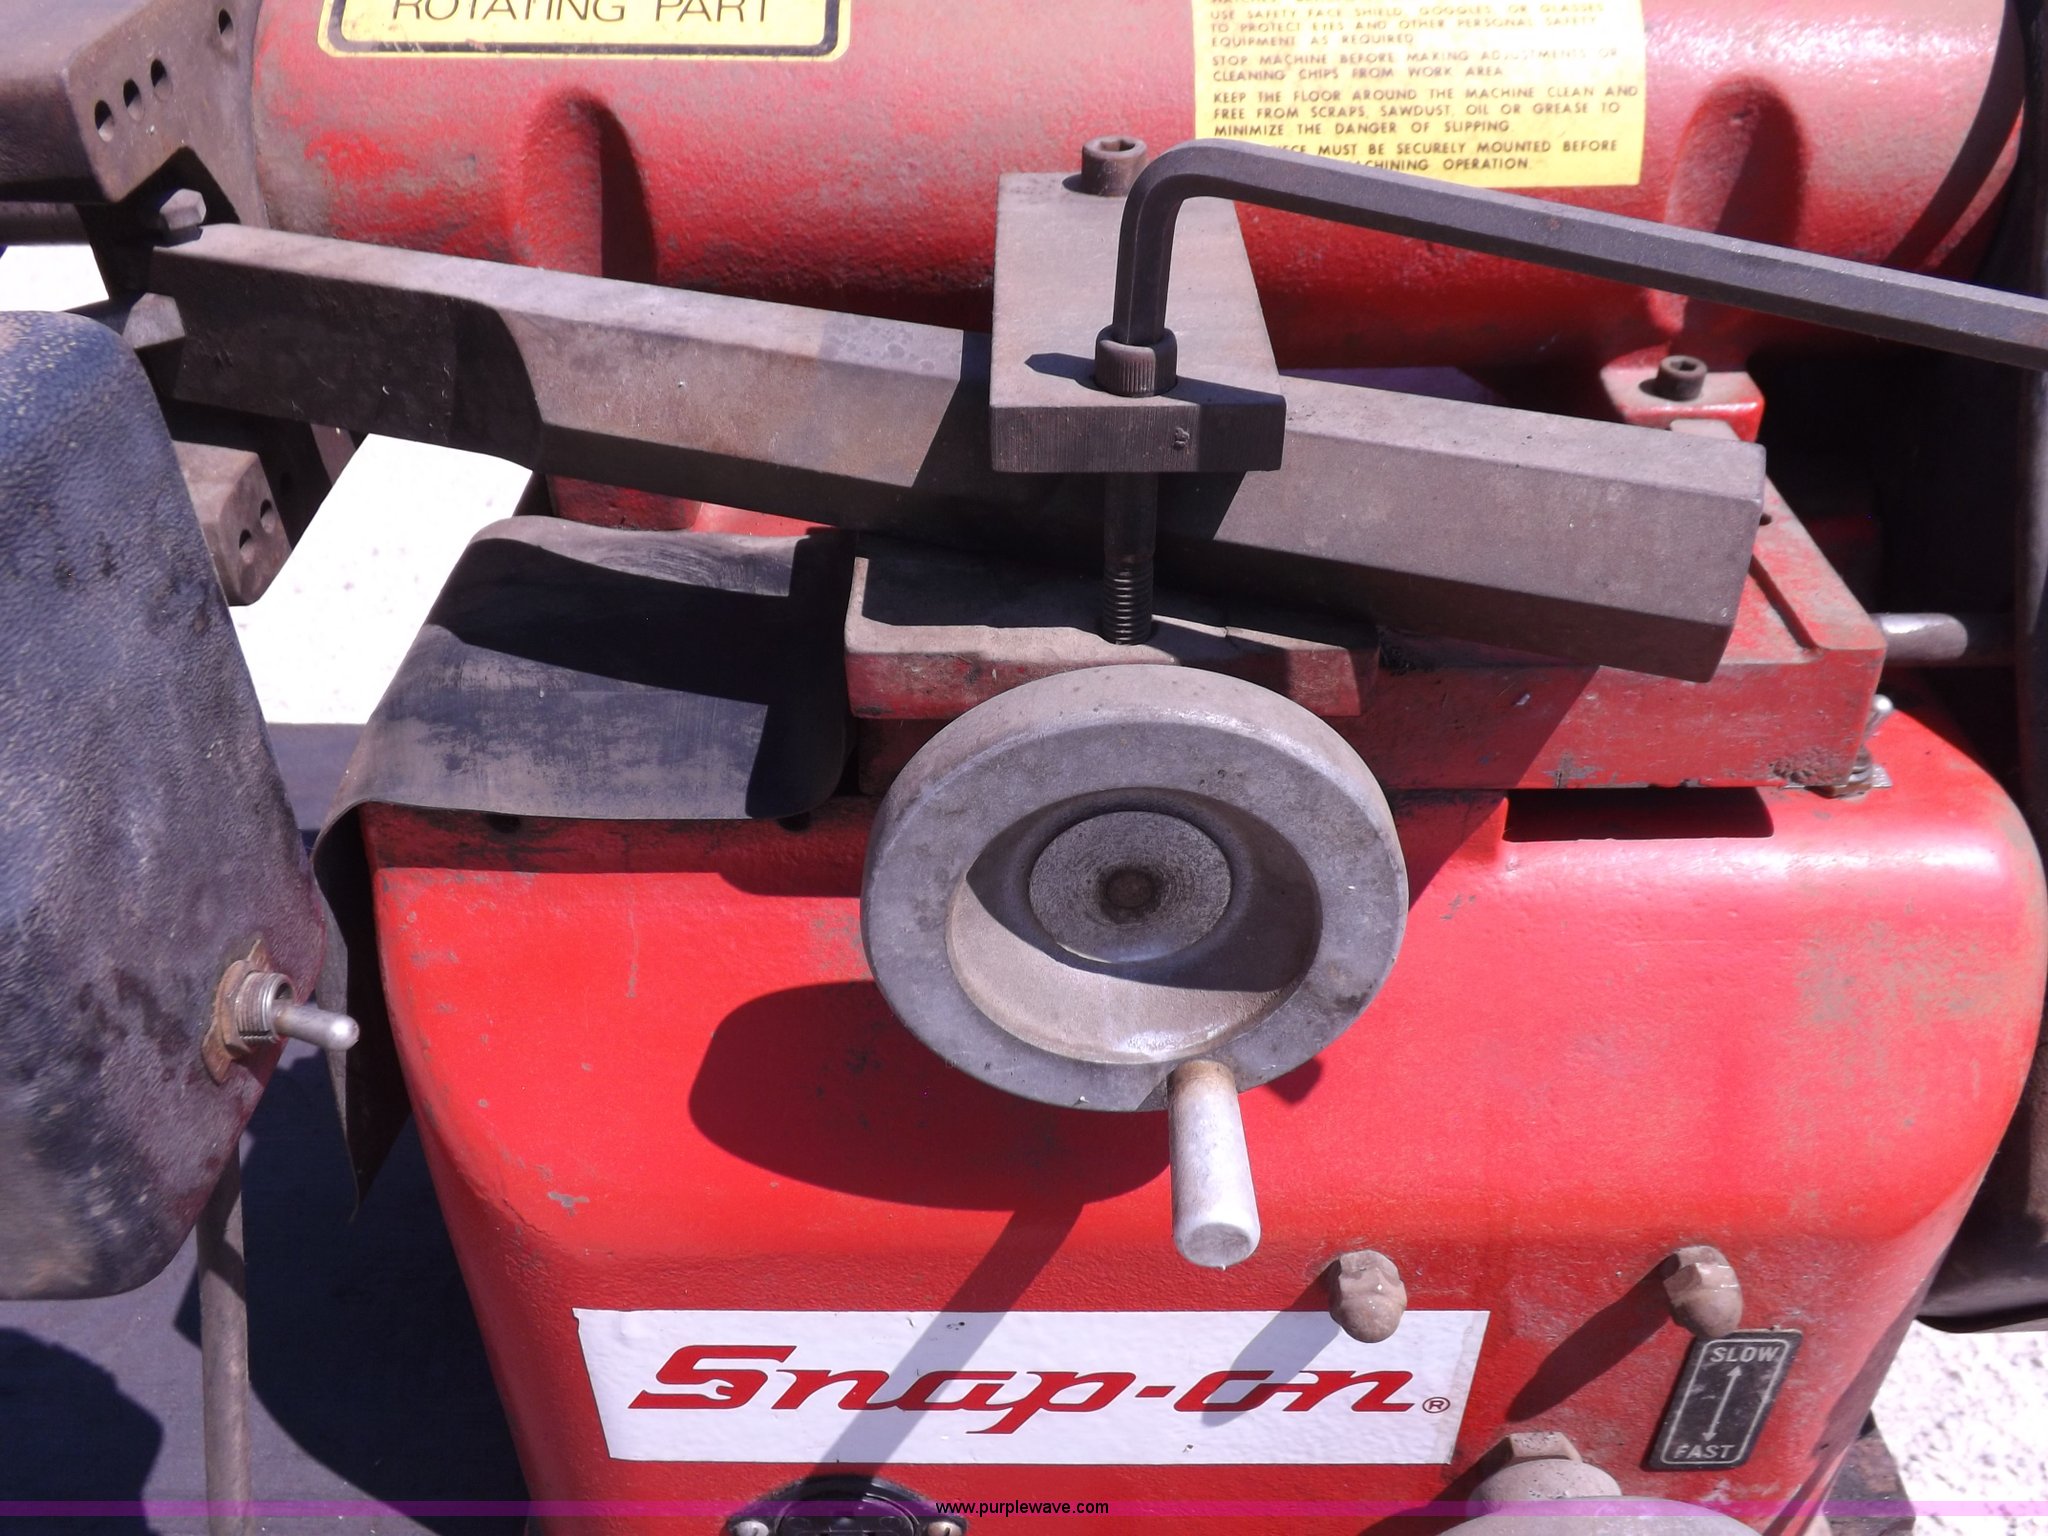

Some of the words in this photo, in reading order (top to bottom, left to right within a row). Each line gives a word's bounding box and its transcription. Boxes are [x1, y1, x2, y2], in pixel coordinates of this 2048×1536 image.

[1211, 10, 1235, 20] USE
[1212, 23, 1229, 33] TO
[1240, 22, 1300, 33] PROTECT
[1356, 20, 1387, 30] AND
[1399, 19, 1445, 30] OTHER
[1212, 36, 1296, 47] EQUIPMENT
[1310, 35, 1329, 45] AS
[1212, 55, 1248, 66] STOP
[1259, 54, 1327, 66] MACHINE
[1340, 53, 1394, 64] BEFORE
[1407, 51, 1469, 62] MAKING
[1213, 71, 1286, 82] CLEANING
[1299, 69, 1339, 80] CHIPS
[1352, 68, 1394, 79] FROM
[1408, 67, 1452, 78] WORK
[1214, 92, 1246, 103] KEEP
[1258, 91, 1281, 102] THE
[1293, 90, 1341, 102] FLOOR
[1352, 89, 1417, 100] AROUND
[1429, 88, 1454, 99] THE
[1465, 87, 1535, 98] MACHINE
[1547, 86, 1595, 97] CLEAN
[1605, 86, 1638, 96] AND
[1214, 108, 1245, 120] FREE
[1257, 107, 1299, 118] FROM
[1466, 104, 1489, 115] OIL
[1501, 103, 1521, 114] OR
[1532, 102, 1588, 114] GREASE
[1601, 102, 1620, 113] TO
[1214, 124, 1284, 136] MINIMIZE
[1297, 123, 1321, 134] THE
[1335, 122, 1397, 134] DANGER
[1411, 121, 1430, 133] OF
[1444, 120, 1510, 132] SLIPPING
[1318, 143, 1357, 156] MUST
[1368, 143, 1385, 155] BE
[1396, 141, 1466, 154] SECURELY
[1477, 140, 1551, 152] MOUNTED
[1563, 139, 1617, 152] BEFORE
[1443, 158, 1529, 170] OPERATION
[1710, 1346, 1781, 1363] SLOW
[628, 1344, 1415, 1435] Snap-on
[1673, 1444, 1736, 1460] FAST
